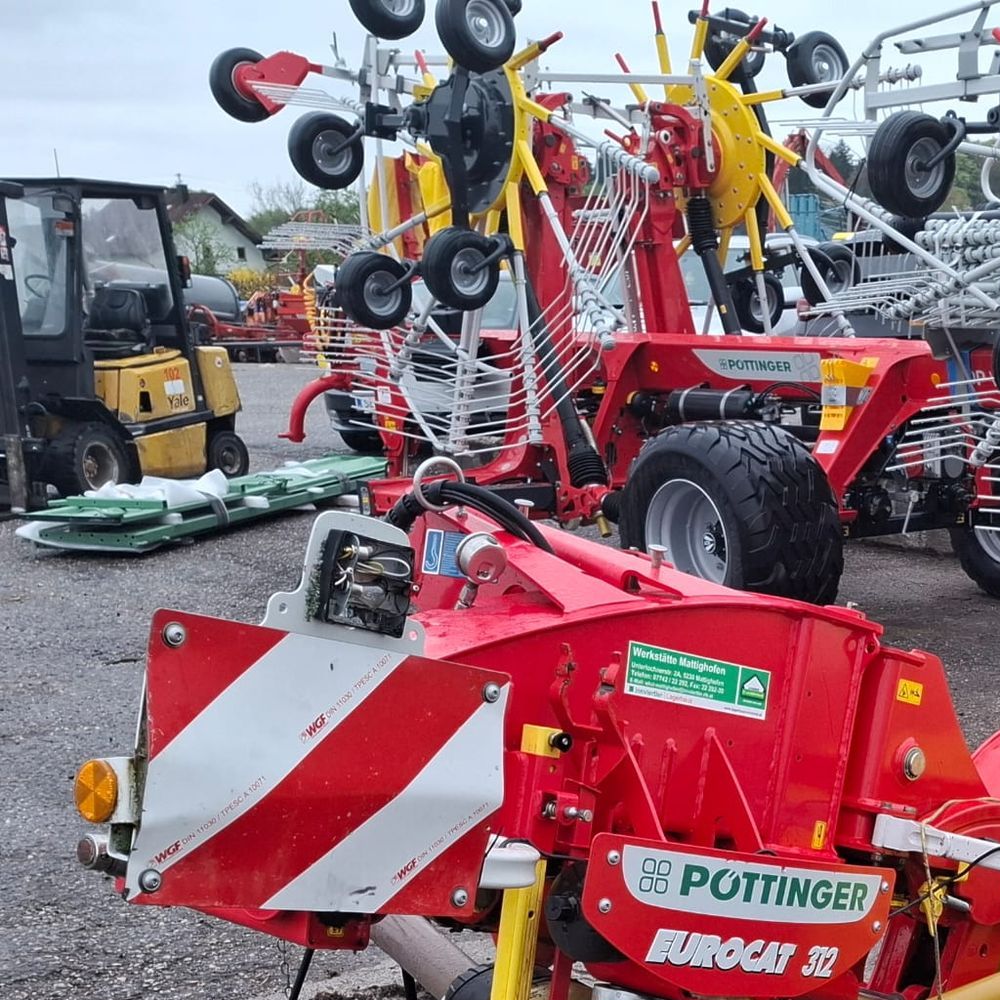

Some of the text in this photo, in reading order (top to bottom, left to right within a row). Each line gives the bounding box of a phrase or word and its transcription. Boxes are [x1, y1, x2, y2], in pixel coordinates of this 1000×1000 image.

[163, 366, 180, 380] 102
[168, 395, 189, 409] Yale
[632, 646, 726, 676] Werkstätte Mattighofen
[305, 713, 328, 738] WGF
[154, 840, 182, 864] WGF
[182, 832, 196, 845] DIN
[397, 857, 417, 880] WGF
[645, 928, 840, 979] EUROCAT 312
